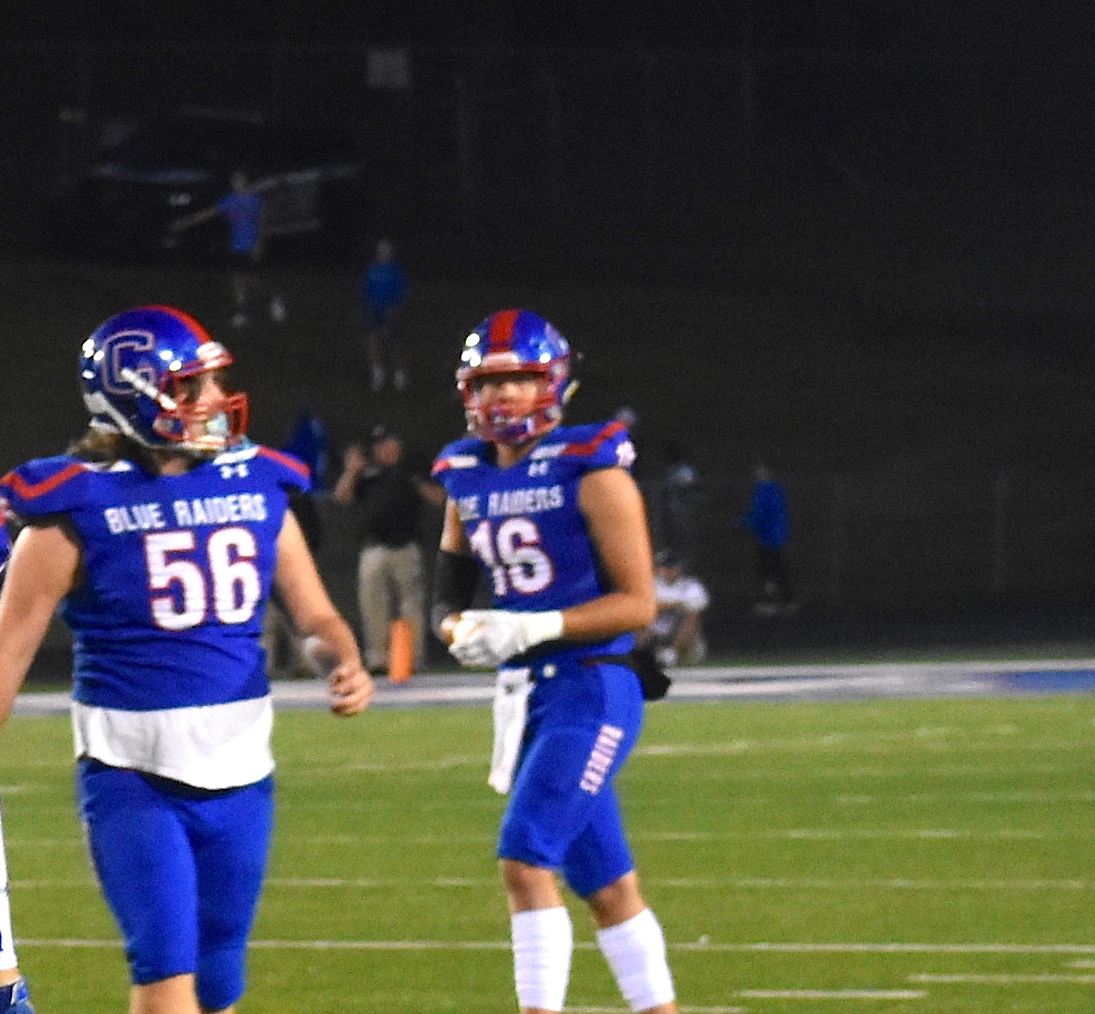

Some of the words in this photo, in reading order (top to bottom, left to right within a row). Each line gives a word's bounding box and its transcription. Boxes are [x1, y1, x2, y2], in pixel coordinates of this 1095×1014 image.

[104, 503, 166, 534] BLUE
[173, 493, 267, 526] RAIDERS
[488, 485, 565, 518] RAIDERS
[142, 524, 262, 632] 56
[469, 516, 555, 597] 16
